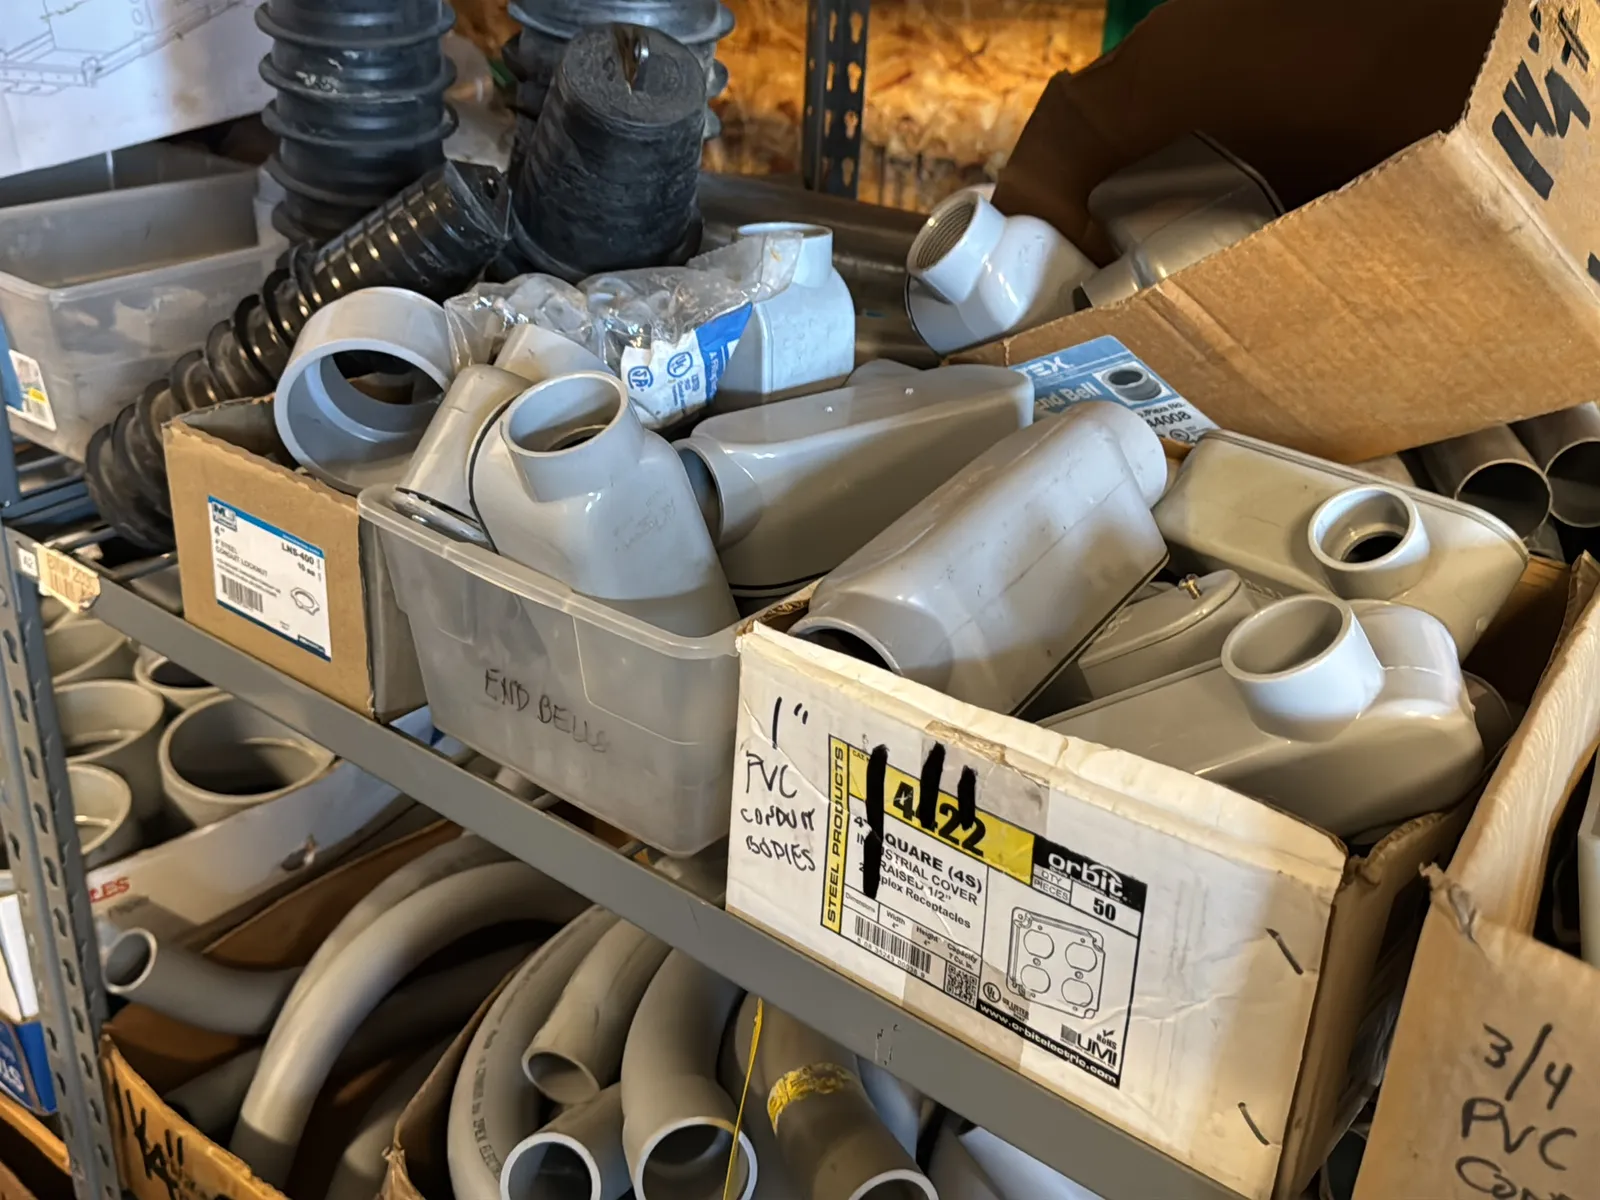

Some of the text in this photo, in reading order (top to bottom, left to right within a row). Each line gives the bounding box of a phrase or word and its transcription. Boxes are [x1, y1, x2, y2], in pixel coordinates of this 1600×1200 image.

[1061, 381, 1101, 401] Bell
[485, 668, 530, 712] END
[772, 696, 808, 749] 1"
[746, 750, 798, 799] PVC
[828, 746, 844, 924] STEEL PRODUCTS
[884, 832, 944, 872] QUARE
[949, 866, 983, 894] (4S)
[1041, 871, 1063, 885] QTY
[905, 886, 972, 930] Receptacles
[927, 886, 952, 903] 1/2"
[931, 875, 979, 907] COVER
[1033, 878, 1069, 902] PIECES
[1092, 896, 1117, 921] 50
[886, 910, 979, 964] Width Height Capacity
[979, 1003, 1118, 1084] www.orbitelectric.com
[1077, 1033, 1118, 1067] UMI
[1482, 1022, 1573, 1111] 3/4
[1461, 1096, 1577, 1171] PVC
